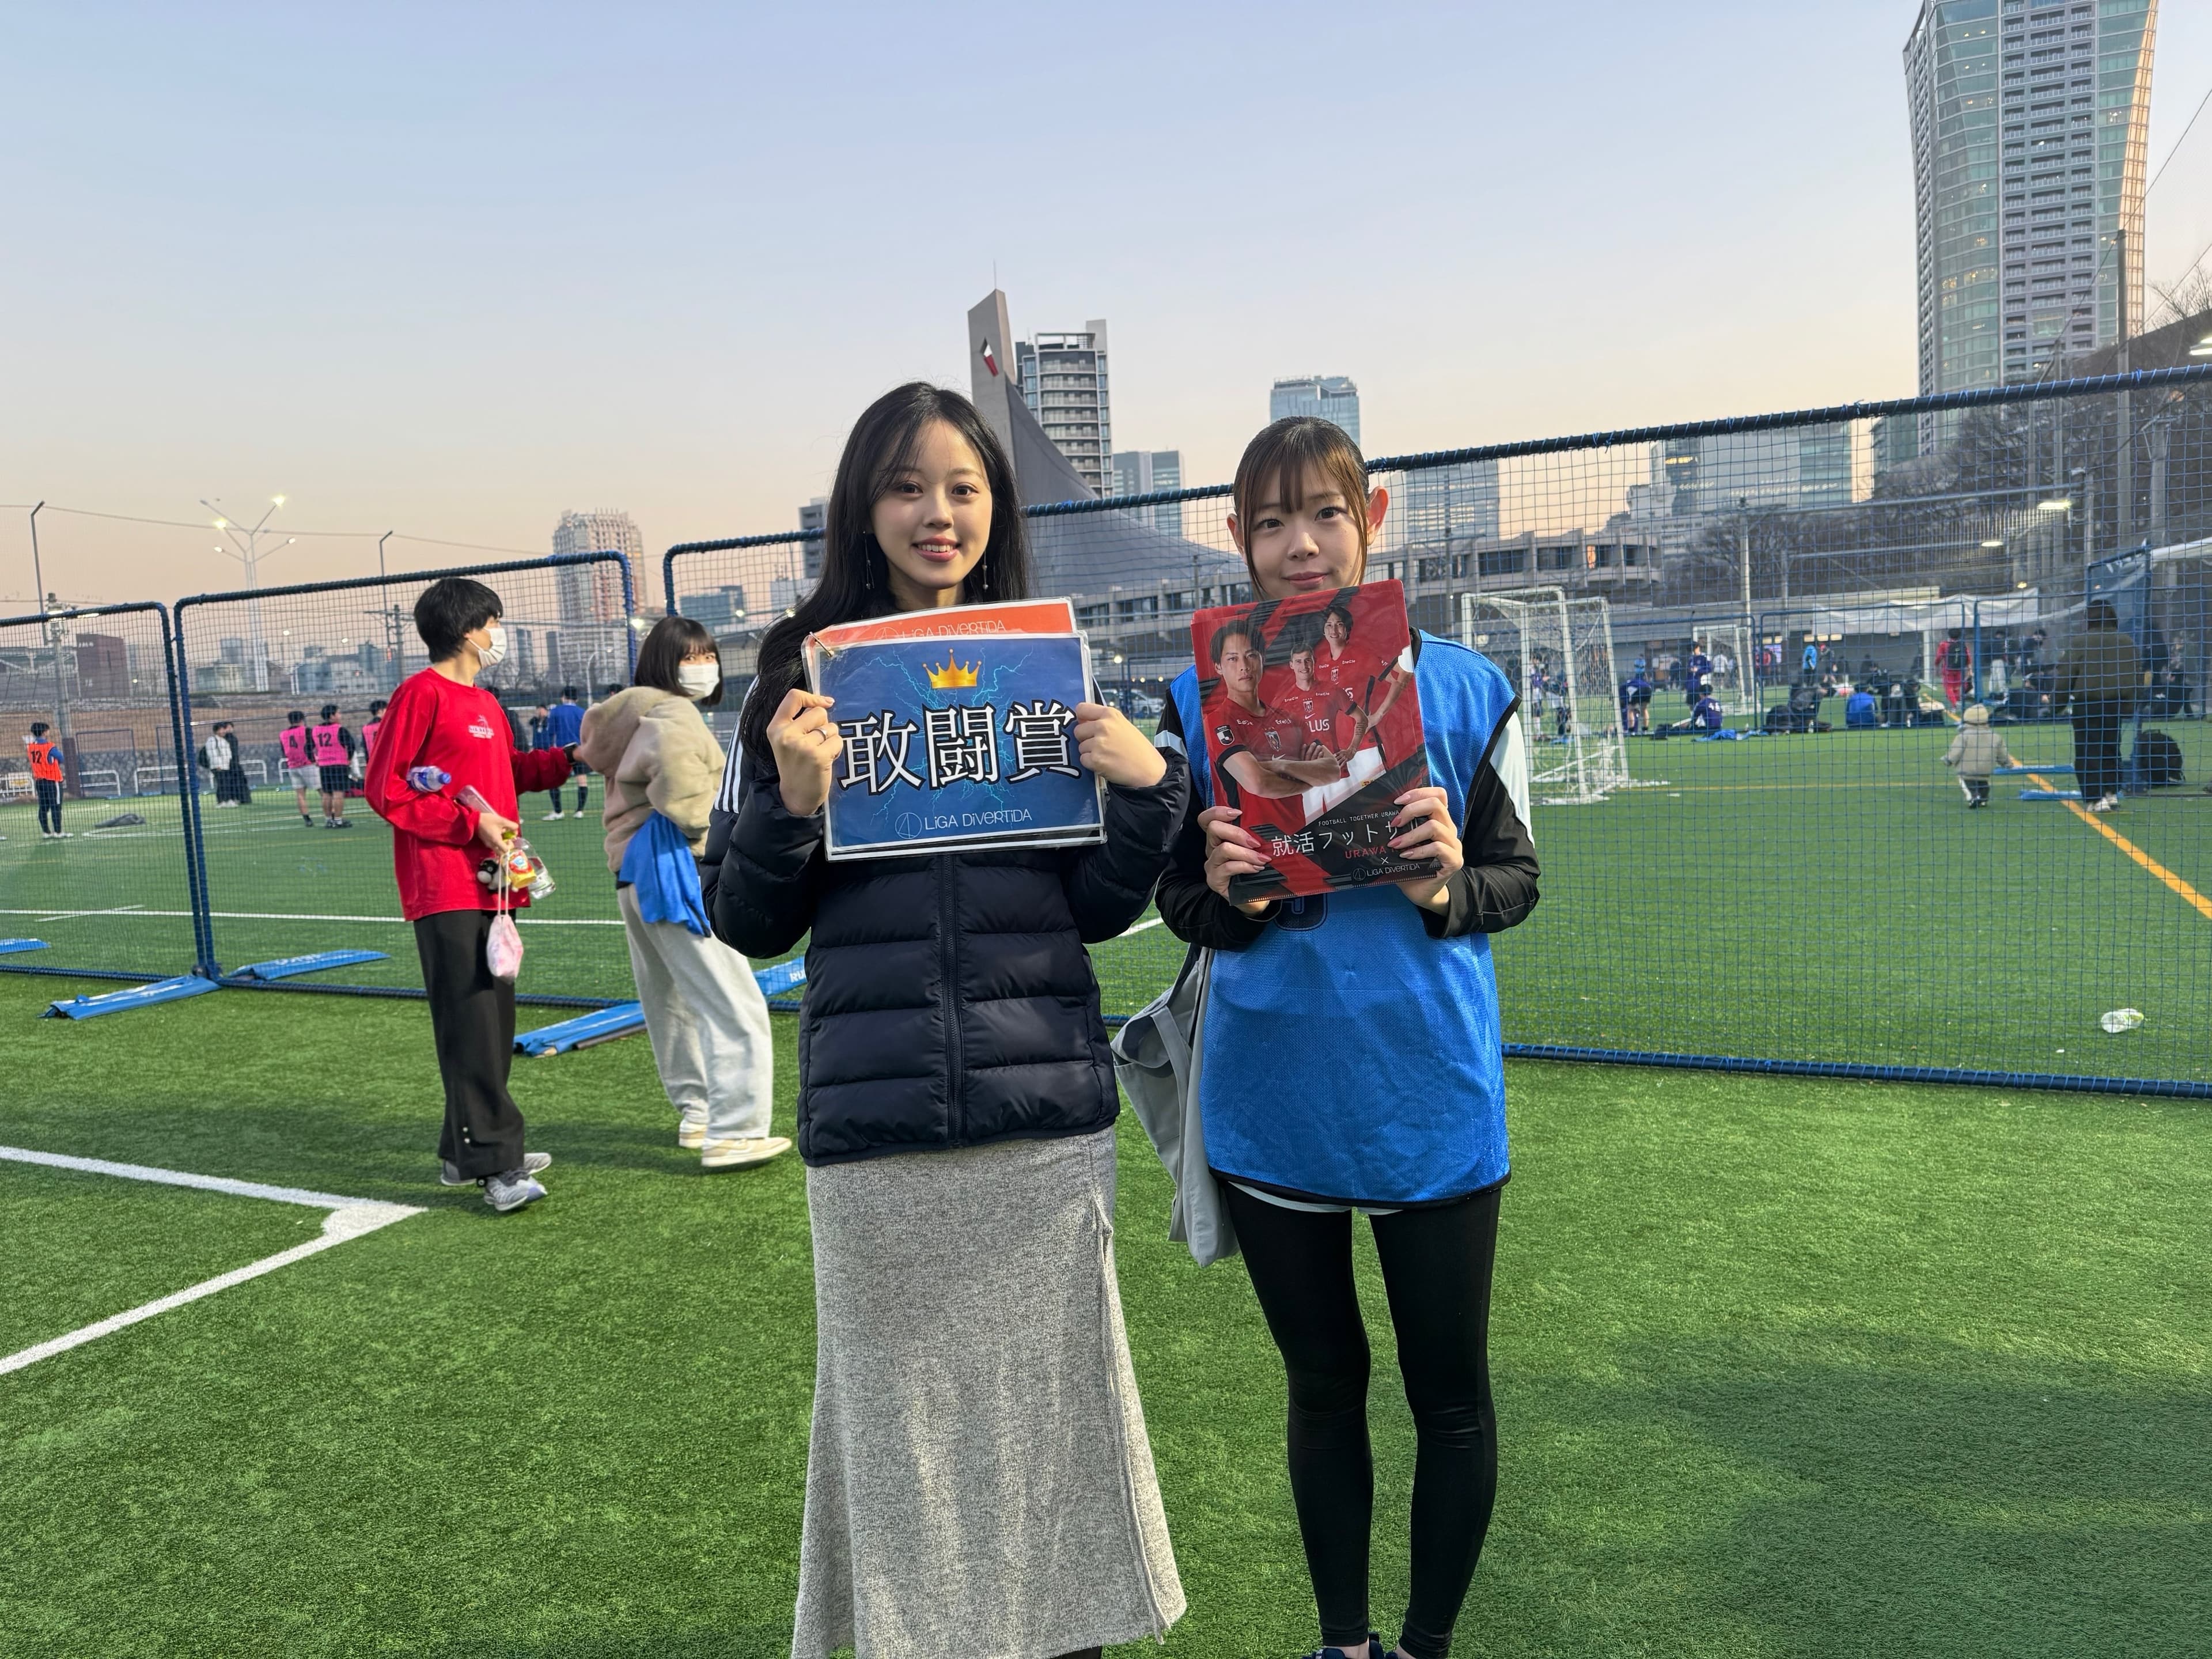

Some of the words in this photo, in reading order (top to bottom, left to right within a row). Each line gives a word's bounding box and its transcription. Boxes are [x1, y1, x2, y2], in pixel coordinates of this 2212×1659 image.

[1306, 718, 1330, 733] LUS
[317, 733, 332, 747] 12
[838, 699, 1082, 796] 敢闘賞
[31, 751, 42, 765] 12
[1318, 817, 1347, 827] FOOTBALL
[1350, 813, 1379, 821] TOGETHER
[1345, 846, 1387, 859] URAWA
